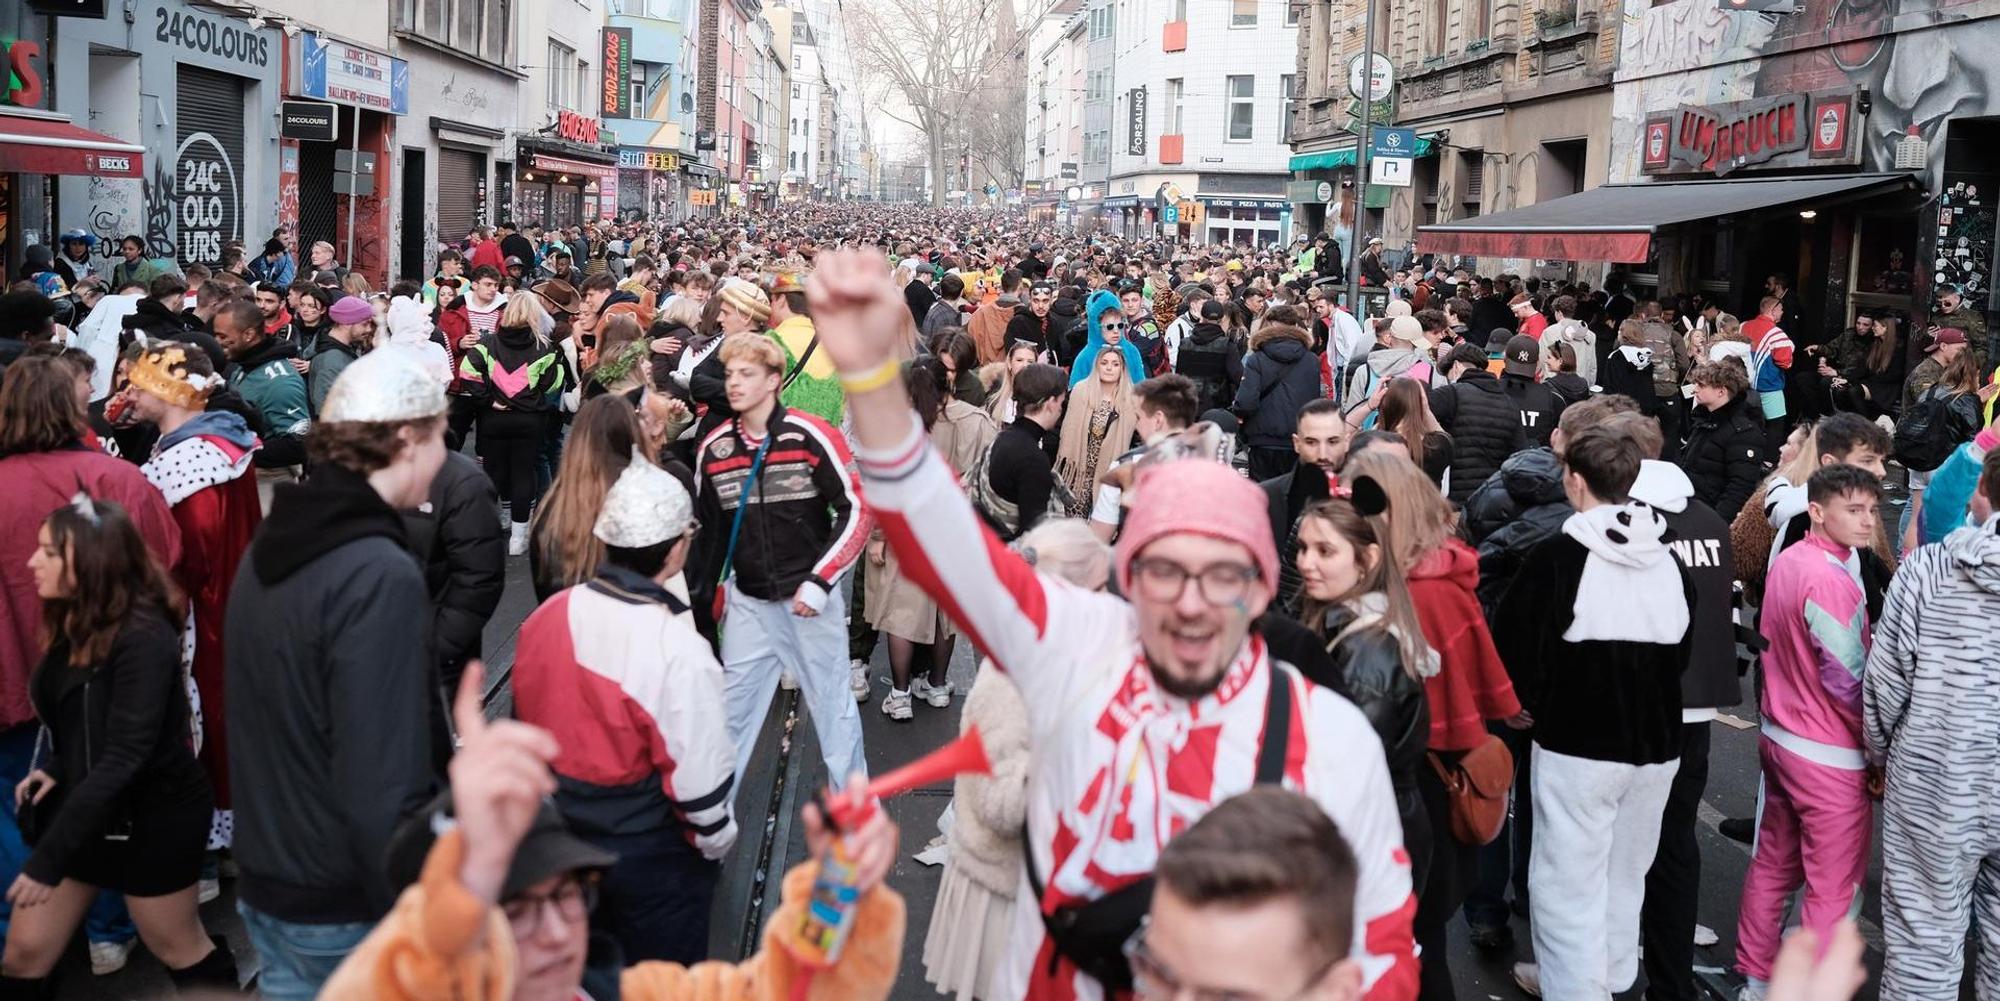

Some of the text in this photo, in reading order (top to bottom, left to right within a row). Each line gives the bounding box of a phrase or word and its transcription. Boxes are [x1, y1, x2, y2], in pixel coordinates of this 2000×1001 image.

[156, 6, 268, 68] 24COLOURS
[0, 40, 43, 107] S
[605, 31, 619, 114] RENDEZVOUS
[287, 116, 328, 125] 24COLOURS
[1678, 102, 1796, 163] UMBRUCH
[184, 159, 222, 193] 24C
[182, 195, 223, 228] OLO
[1166, 208, 1176, 221] P
[184, 230, 221, 263] URS
[264, 361, 290, 380] 11
[1669, 539, 1721, 567] WAT
